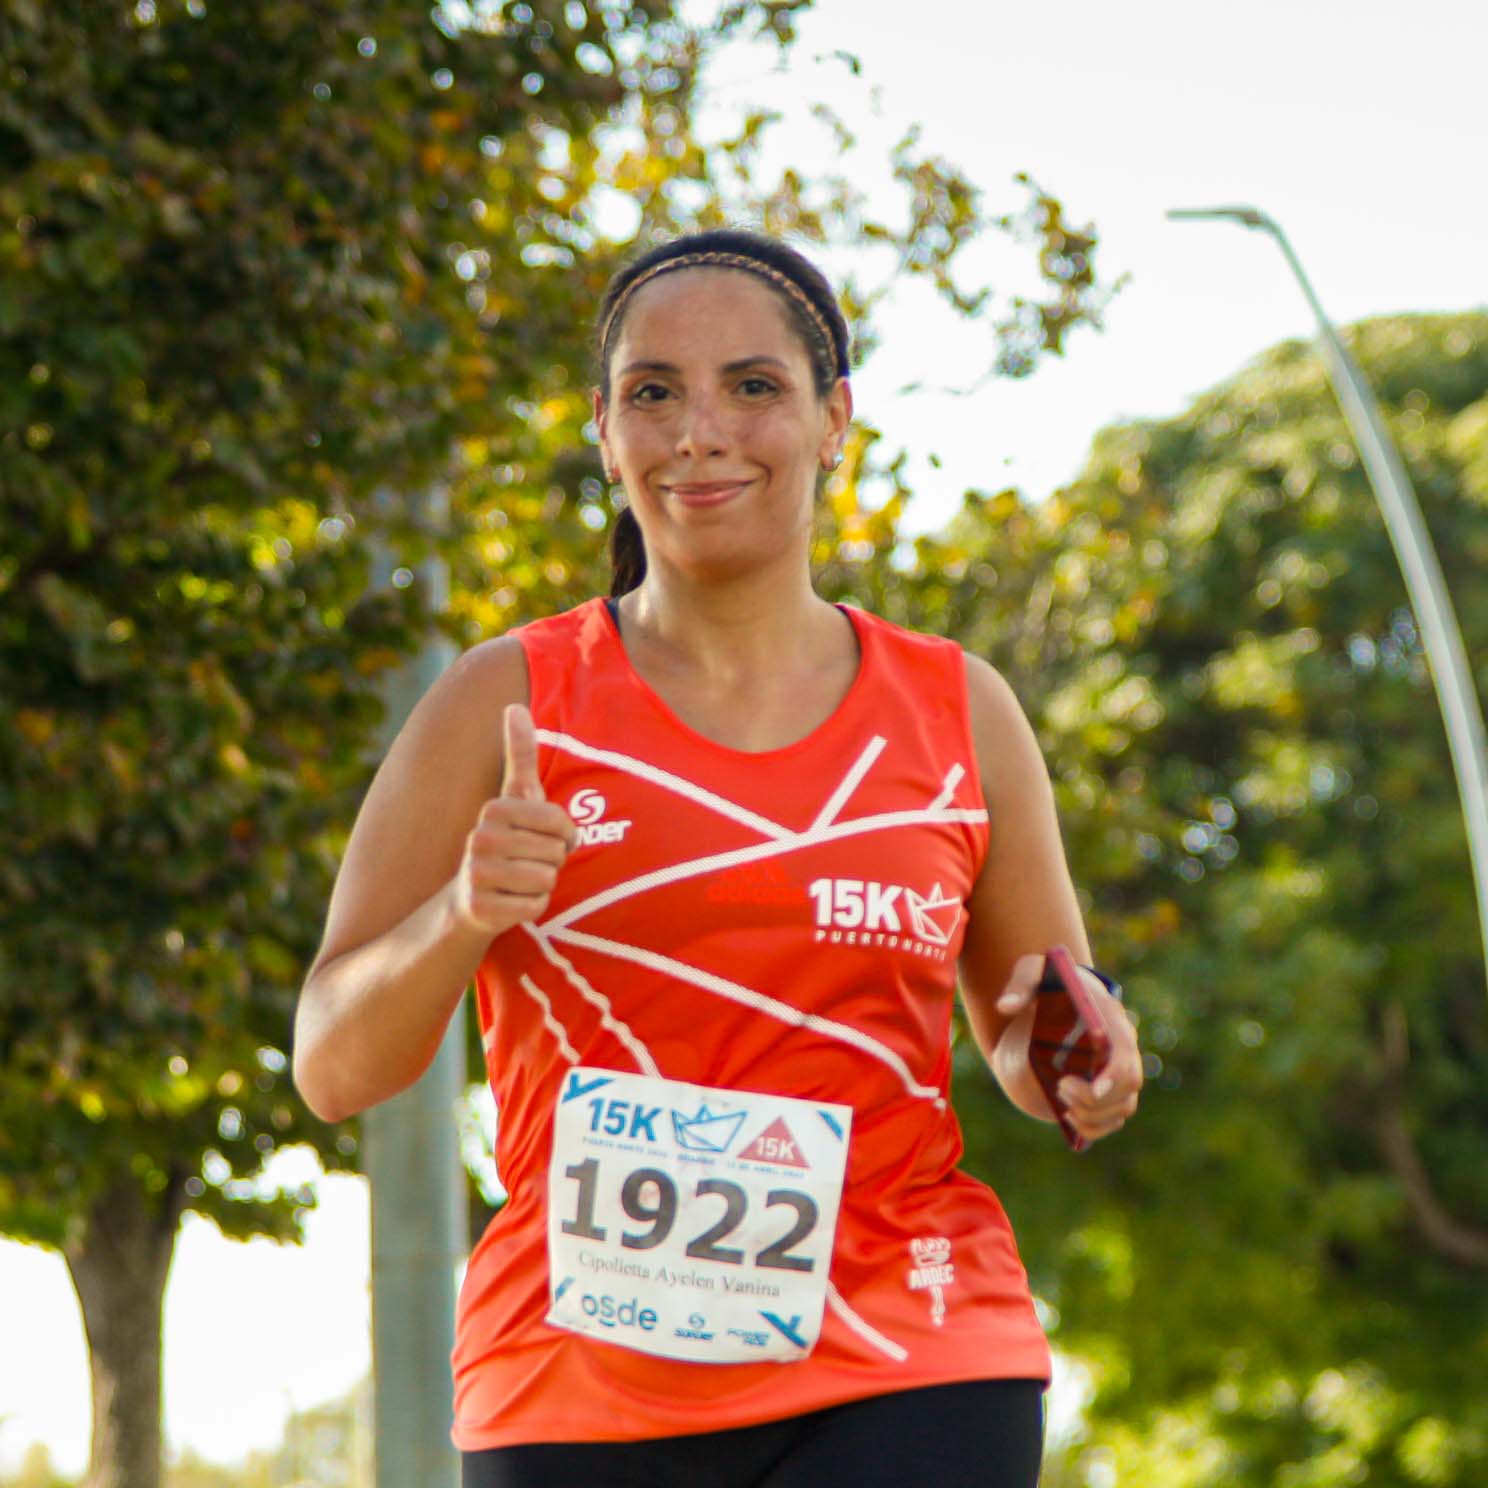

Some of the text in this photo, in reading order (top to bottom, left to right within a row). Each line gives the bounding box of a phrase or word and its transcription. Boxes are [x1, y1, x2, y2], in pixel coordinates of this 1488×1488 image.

[809, 878, 903, 932] 15K
[815, 929, 947, 961] PUERTO NORTE
[588, 1097, 663, 1142] 15K
[756, 1136, 796, 1162] 15K
[562, 1156, 820, 1273] 1922
[581, 1293, 659, 1332] osde
